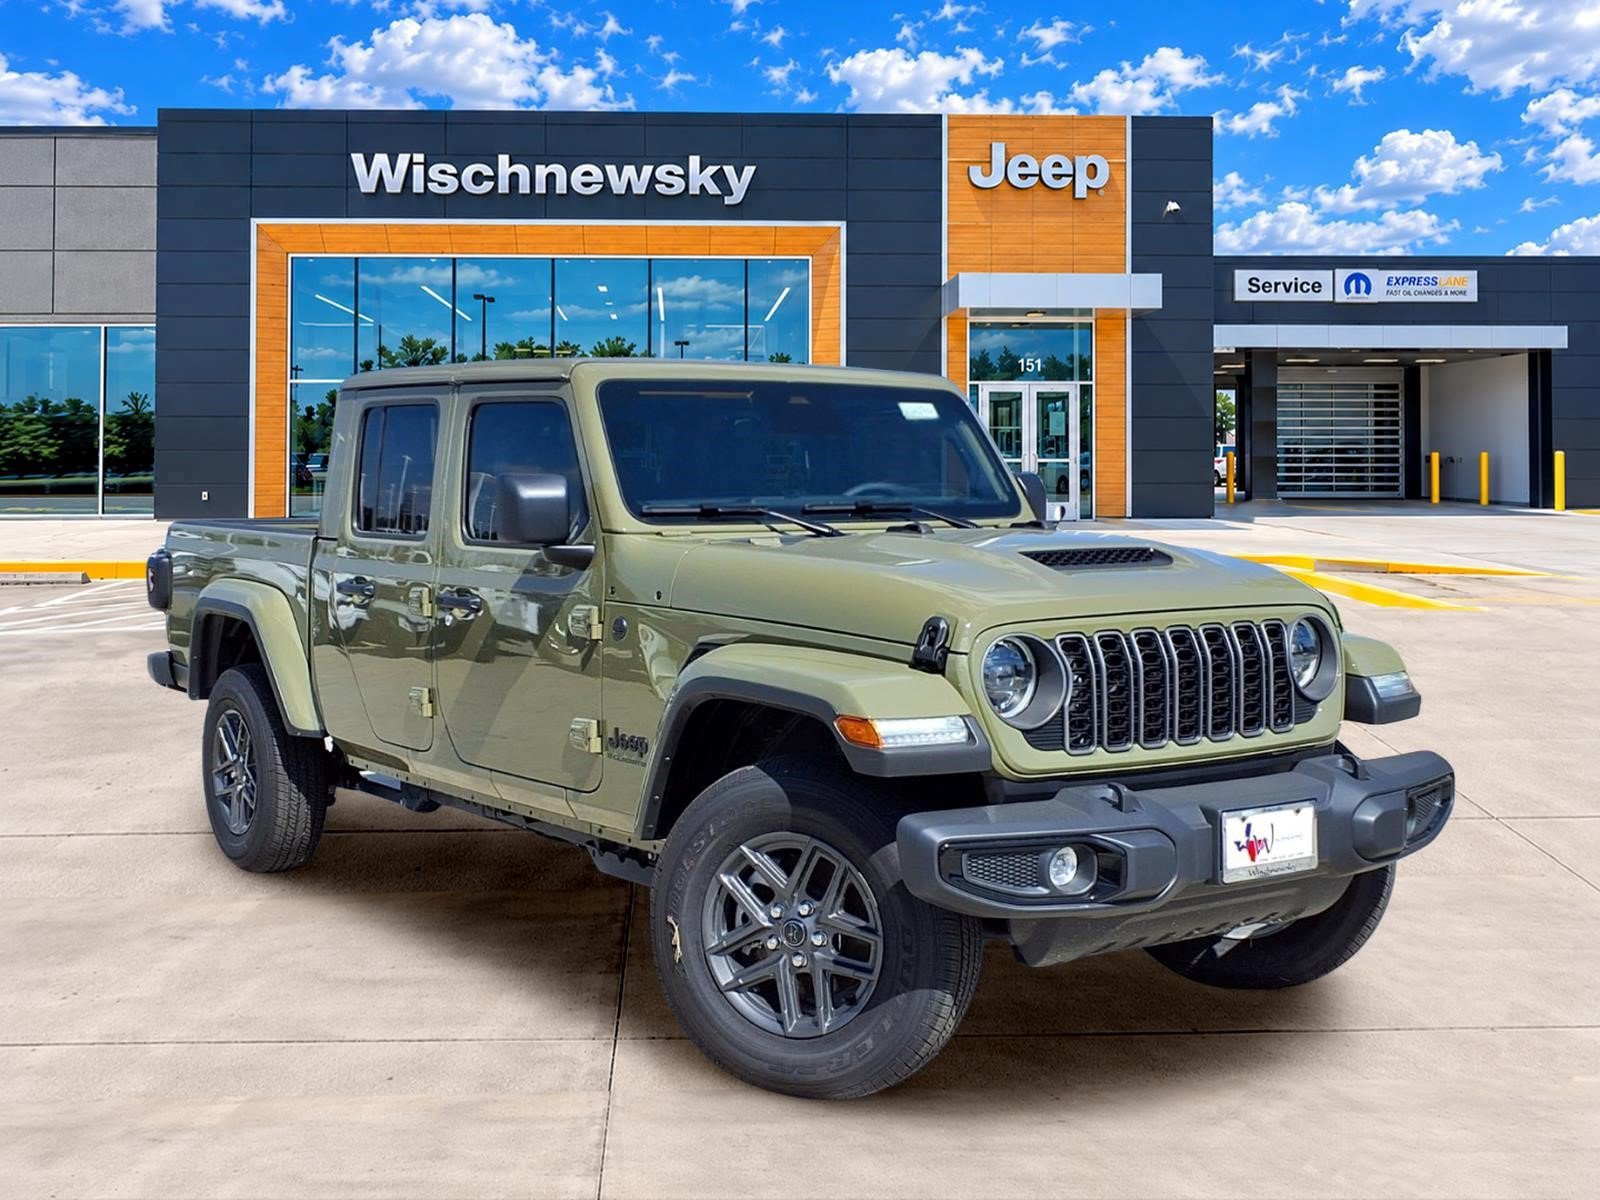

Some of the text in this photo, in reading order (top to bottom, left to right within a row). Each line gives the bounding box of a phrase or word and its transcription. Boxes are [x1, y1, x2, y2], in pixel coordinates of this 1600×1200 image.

[350, 152, 757, 205] Wischnewsky
[968, 141, 1110, 199] Jeep
[1247, 277, 1323, 293] Service
[1017, 358, 1042, 373] 151
[608, 727, 649, 758] Jeep
